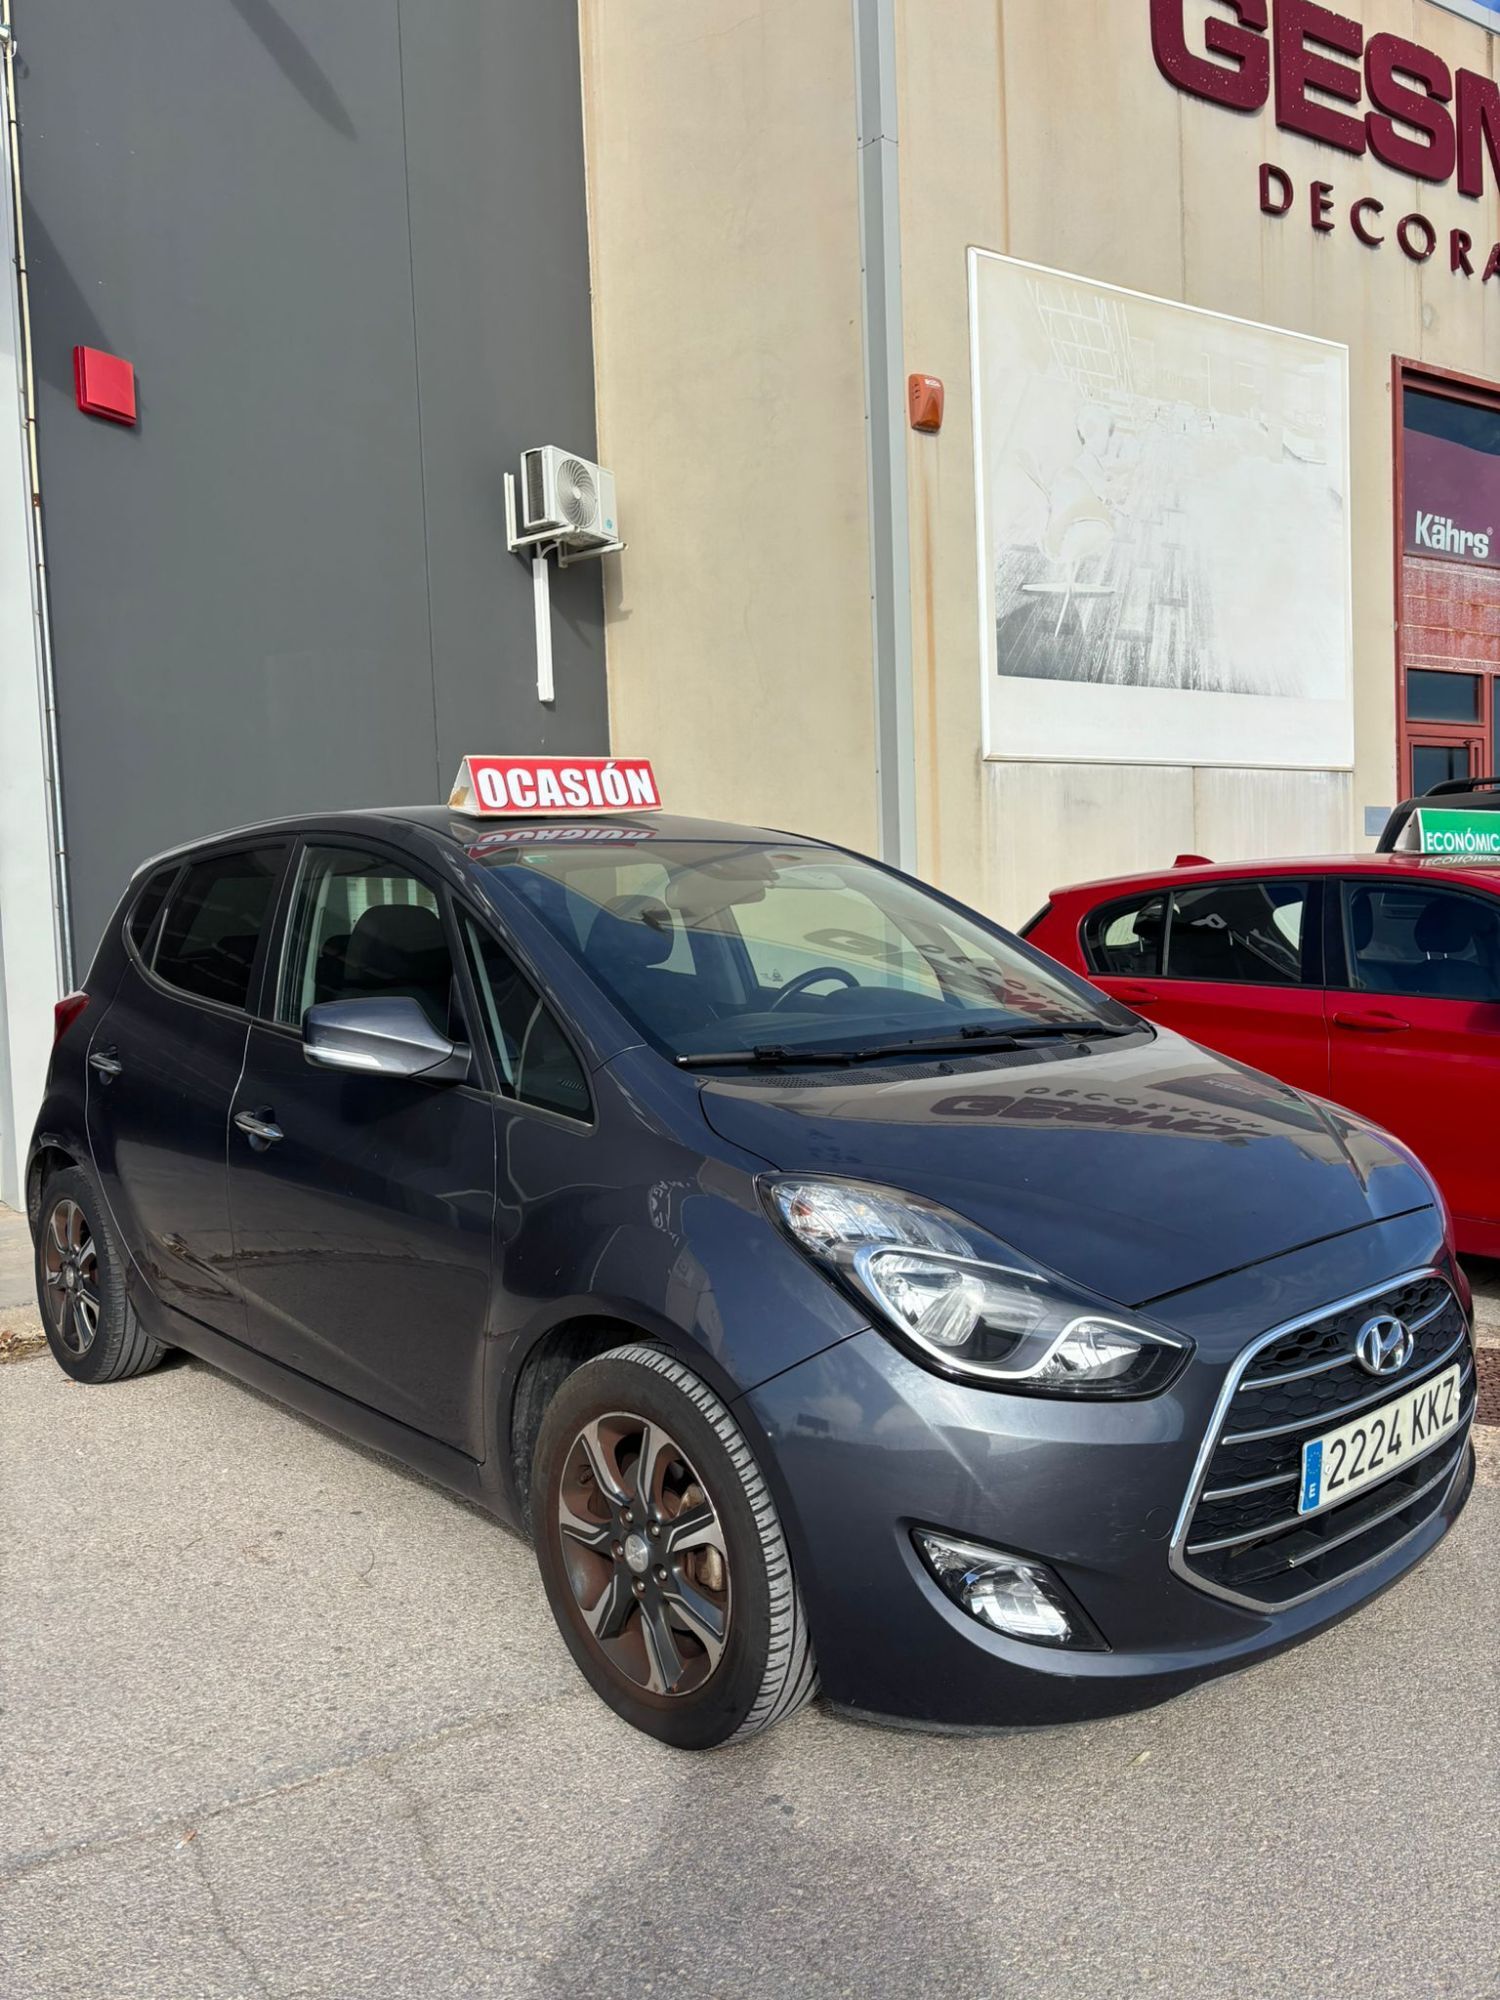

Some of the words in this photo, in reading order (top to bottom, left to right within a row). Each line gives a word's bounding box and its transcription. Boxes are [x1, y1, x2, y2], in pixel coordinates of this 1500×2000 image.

[1415, 510, 1489, 559] Kährs
[476, 762, 656, 808] OCASIÓN
[1327, 1409, 1402, 1491] 2224
[1412, 1375, 1455, 1445] KKZ
[1309, 1482, 1317, 1499] E
